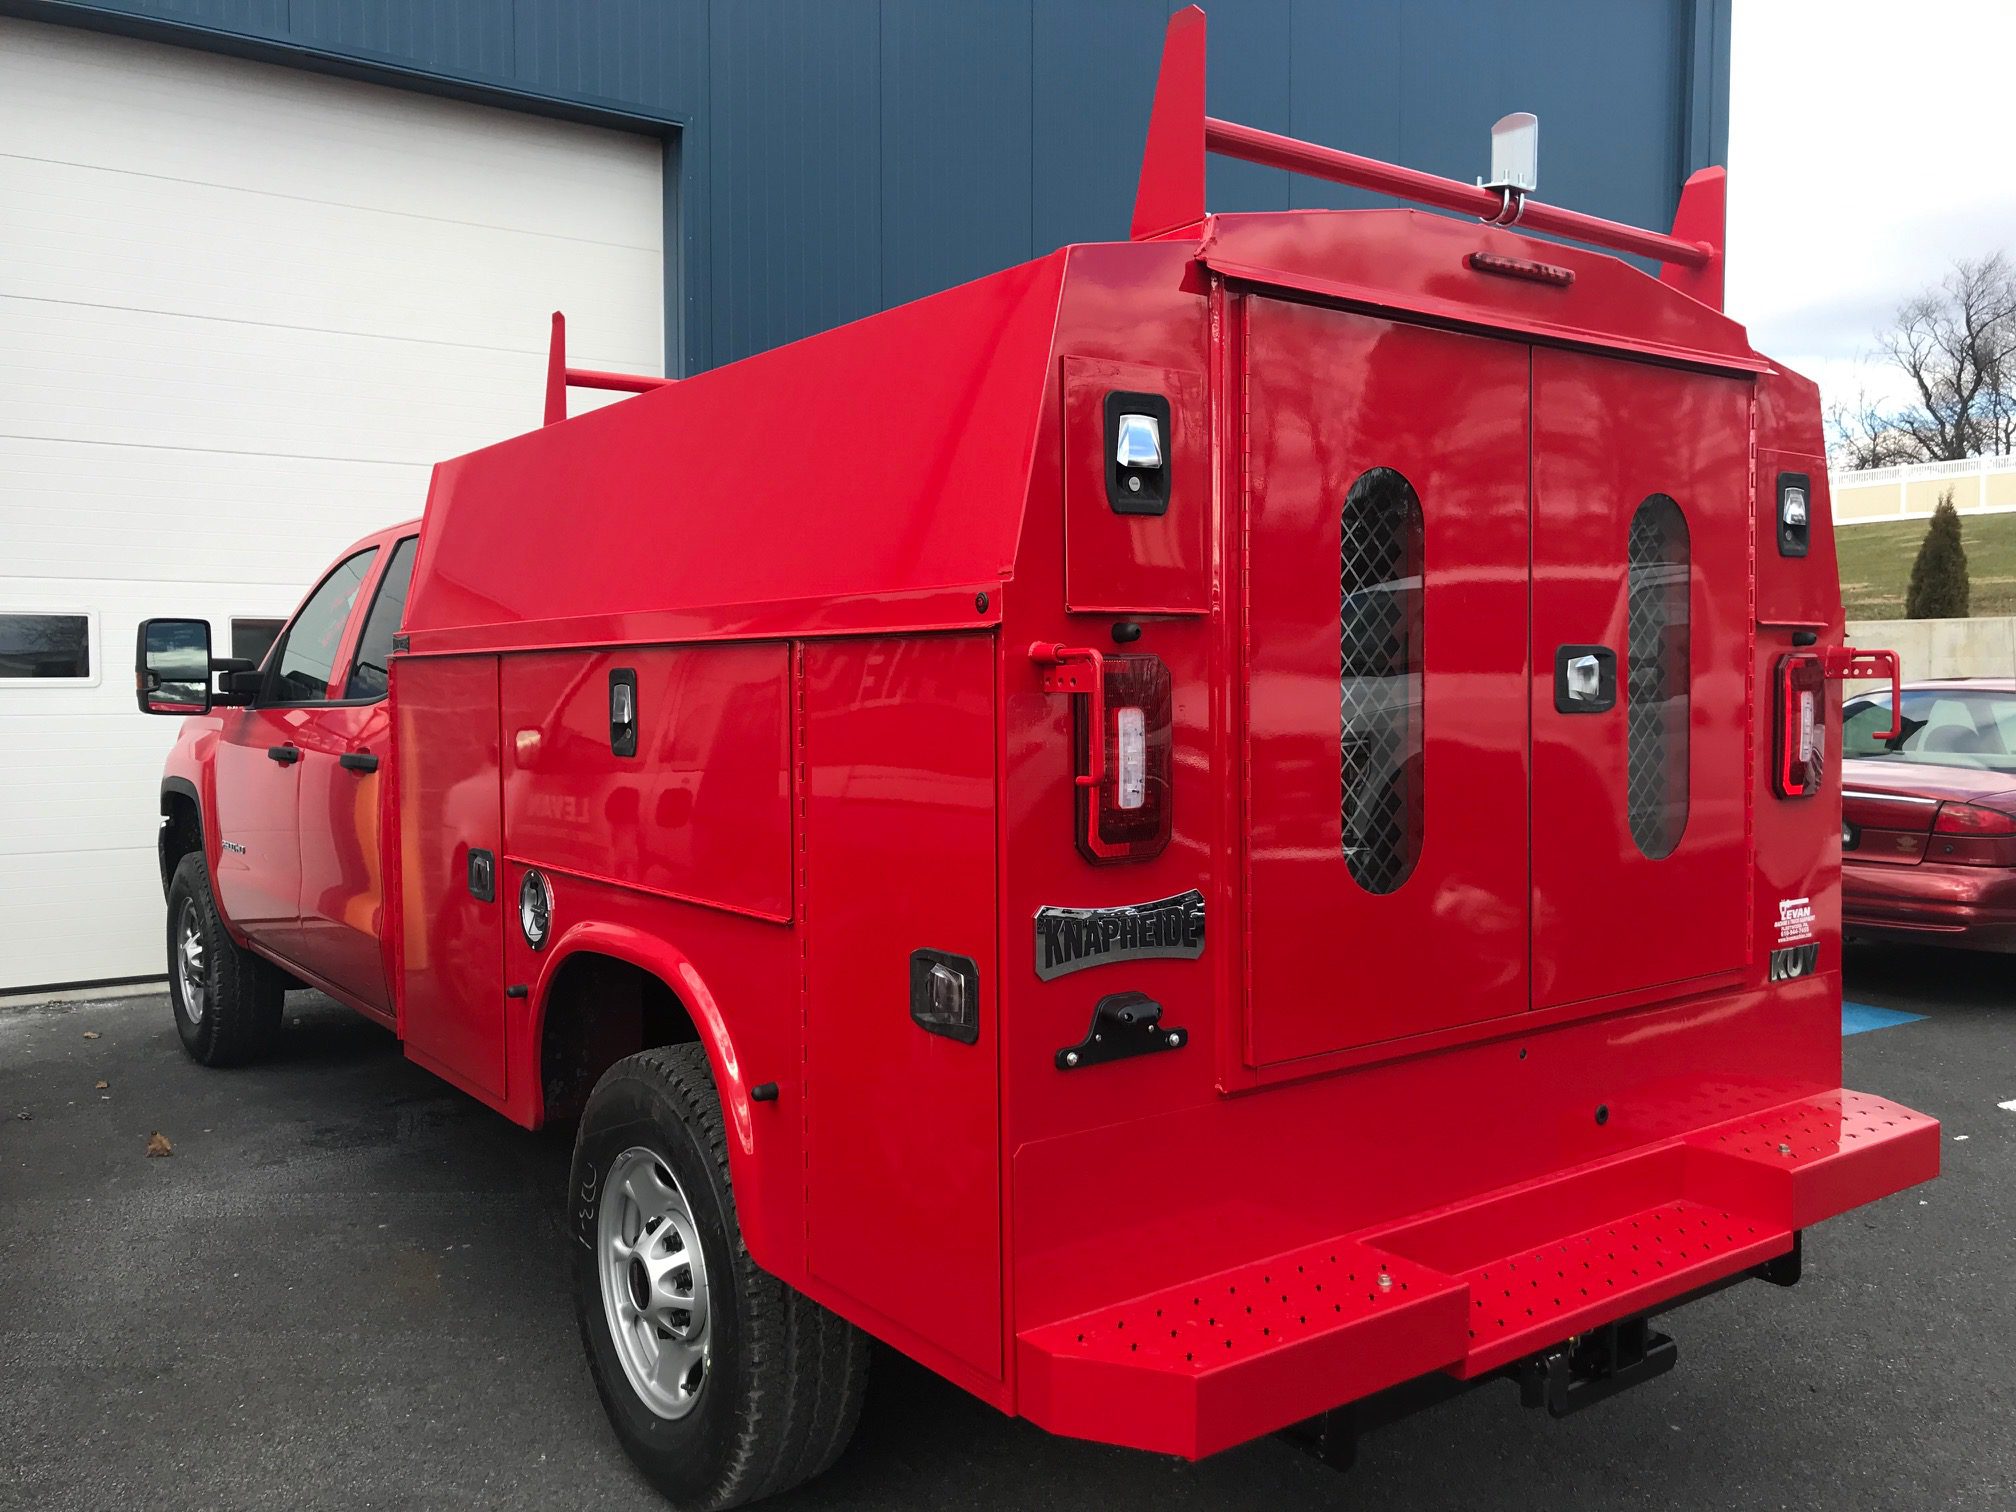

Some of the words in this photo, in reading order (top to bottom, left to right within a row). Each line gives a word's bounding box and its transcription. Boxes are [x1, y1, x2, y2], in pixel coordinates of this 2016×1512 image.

[1780, 906, 1811, 921] LEVAN
[1042, 900, 1200, 969] KNAPHEIDE
[1771, 942, 1820, 982] KUV
